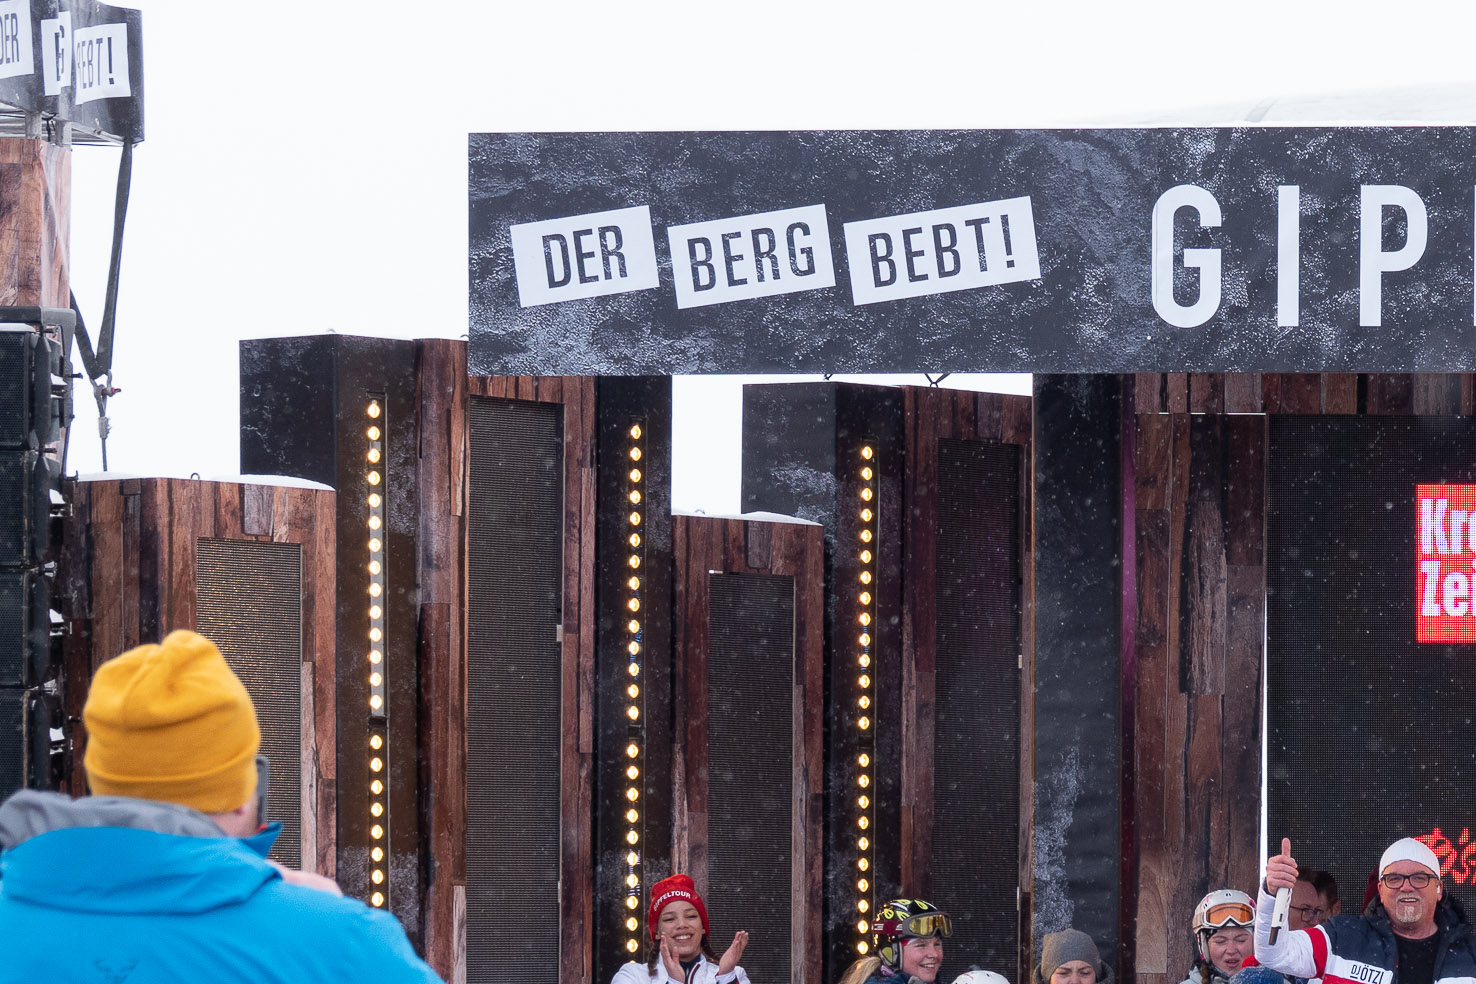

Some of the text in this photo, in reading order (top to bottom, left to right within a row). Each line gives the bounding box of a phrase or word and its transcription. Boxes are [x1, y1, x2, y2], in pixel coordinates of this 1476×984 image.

[542, 214, 1016, 293] DER BERG BEBT!
